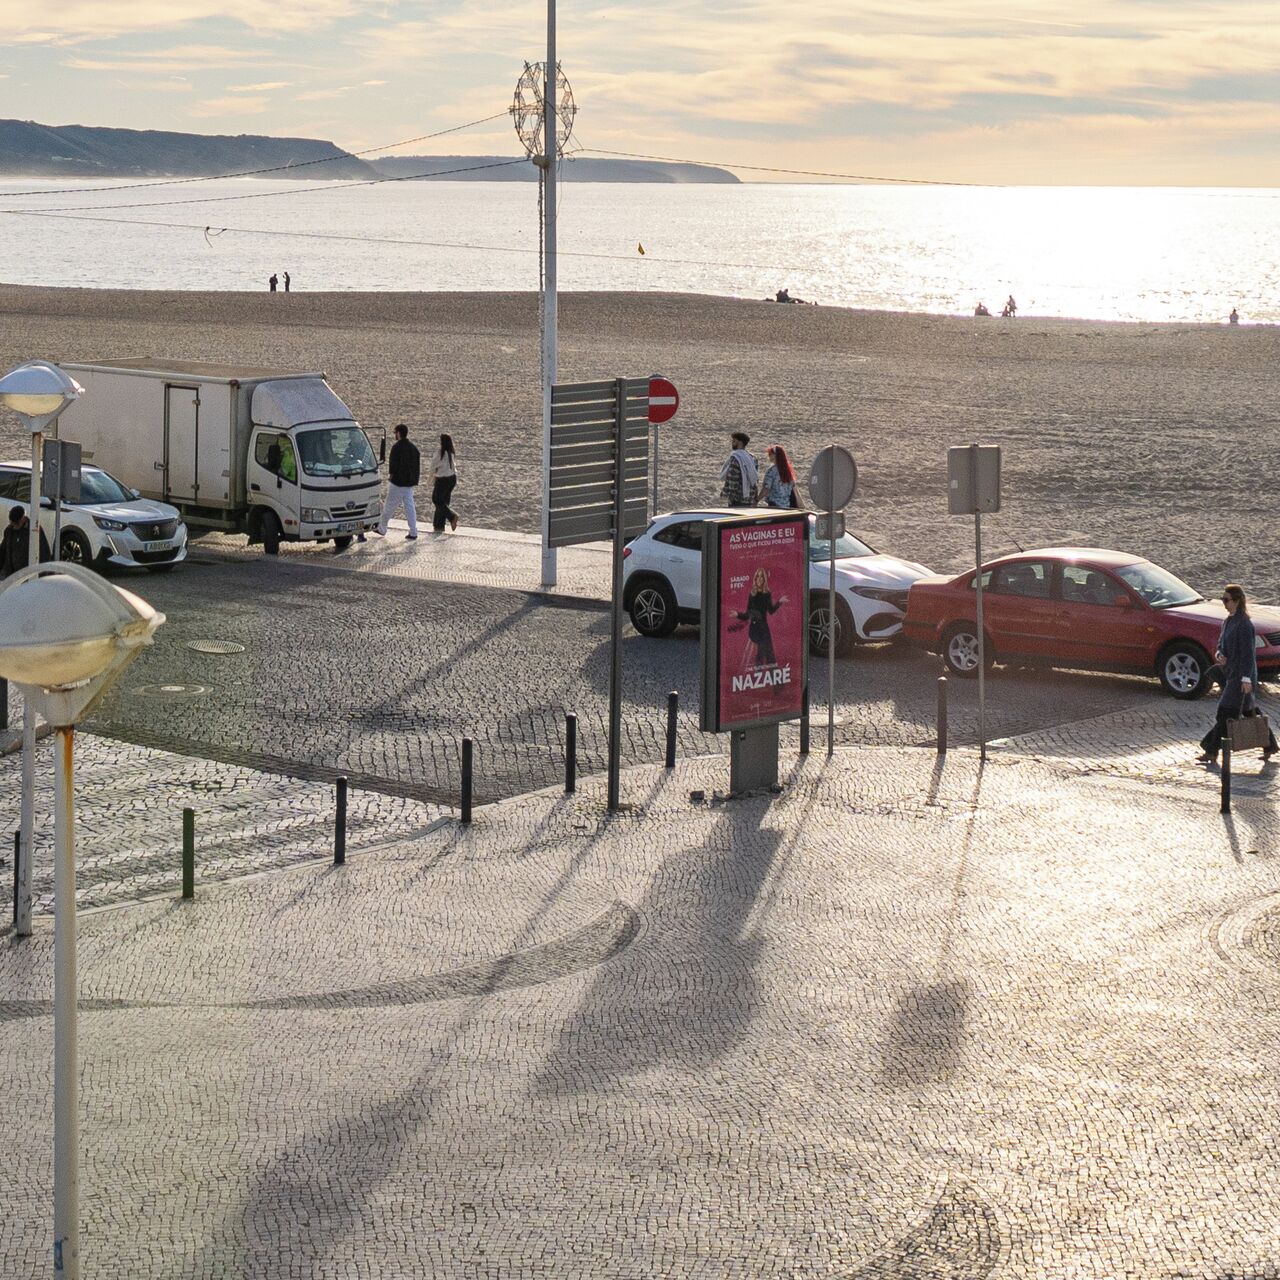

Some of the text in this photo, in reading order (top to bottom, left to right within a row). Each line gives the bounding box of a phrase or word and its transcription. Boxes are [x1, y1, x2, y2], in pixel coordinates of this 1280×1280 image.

[730, 528, 795, 543] AS VAGINAS E EU
[732, 663, 791, 692] NAZARÉ
